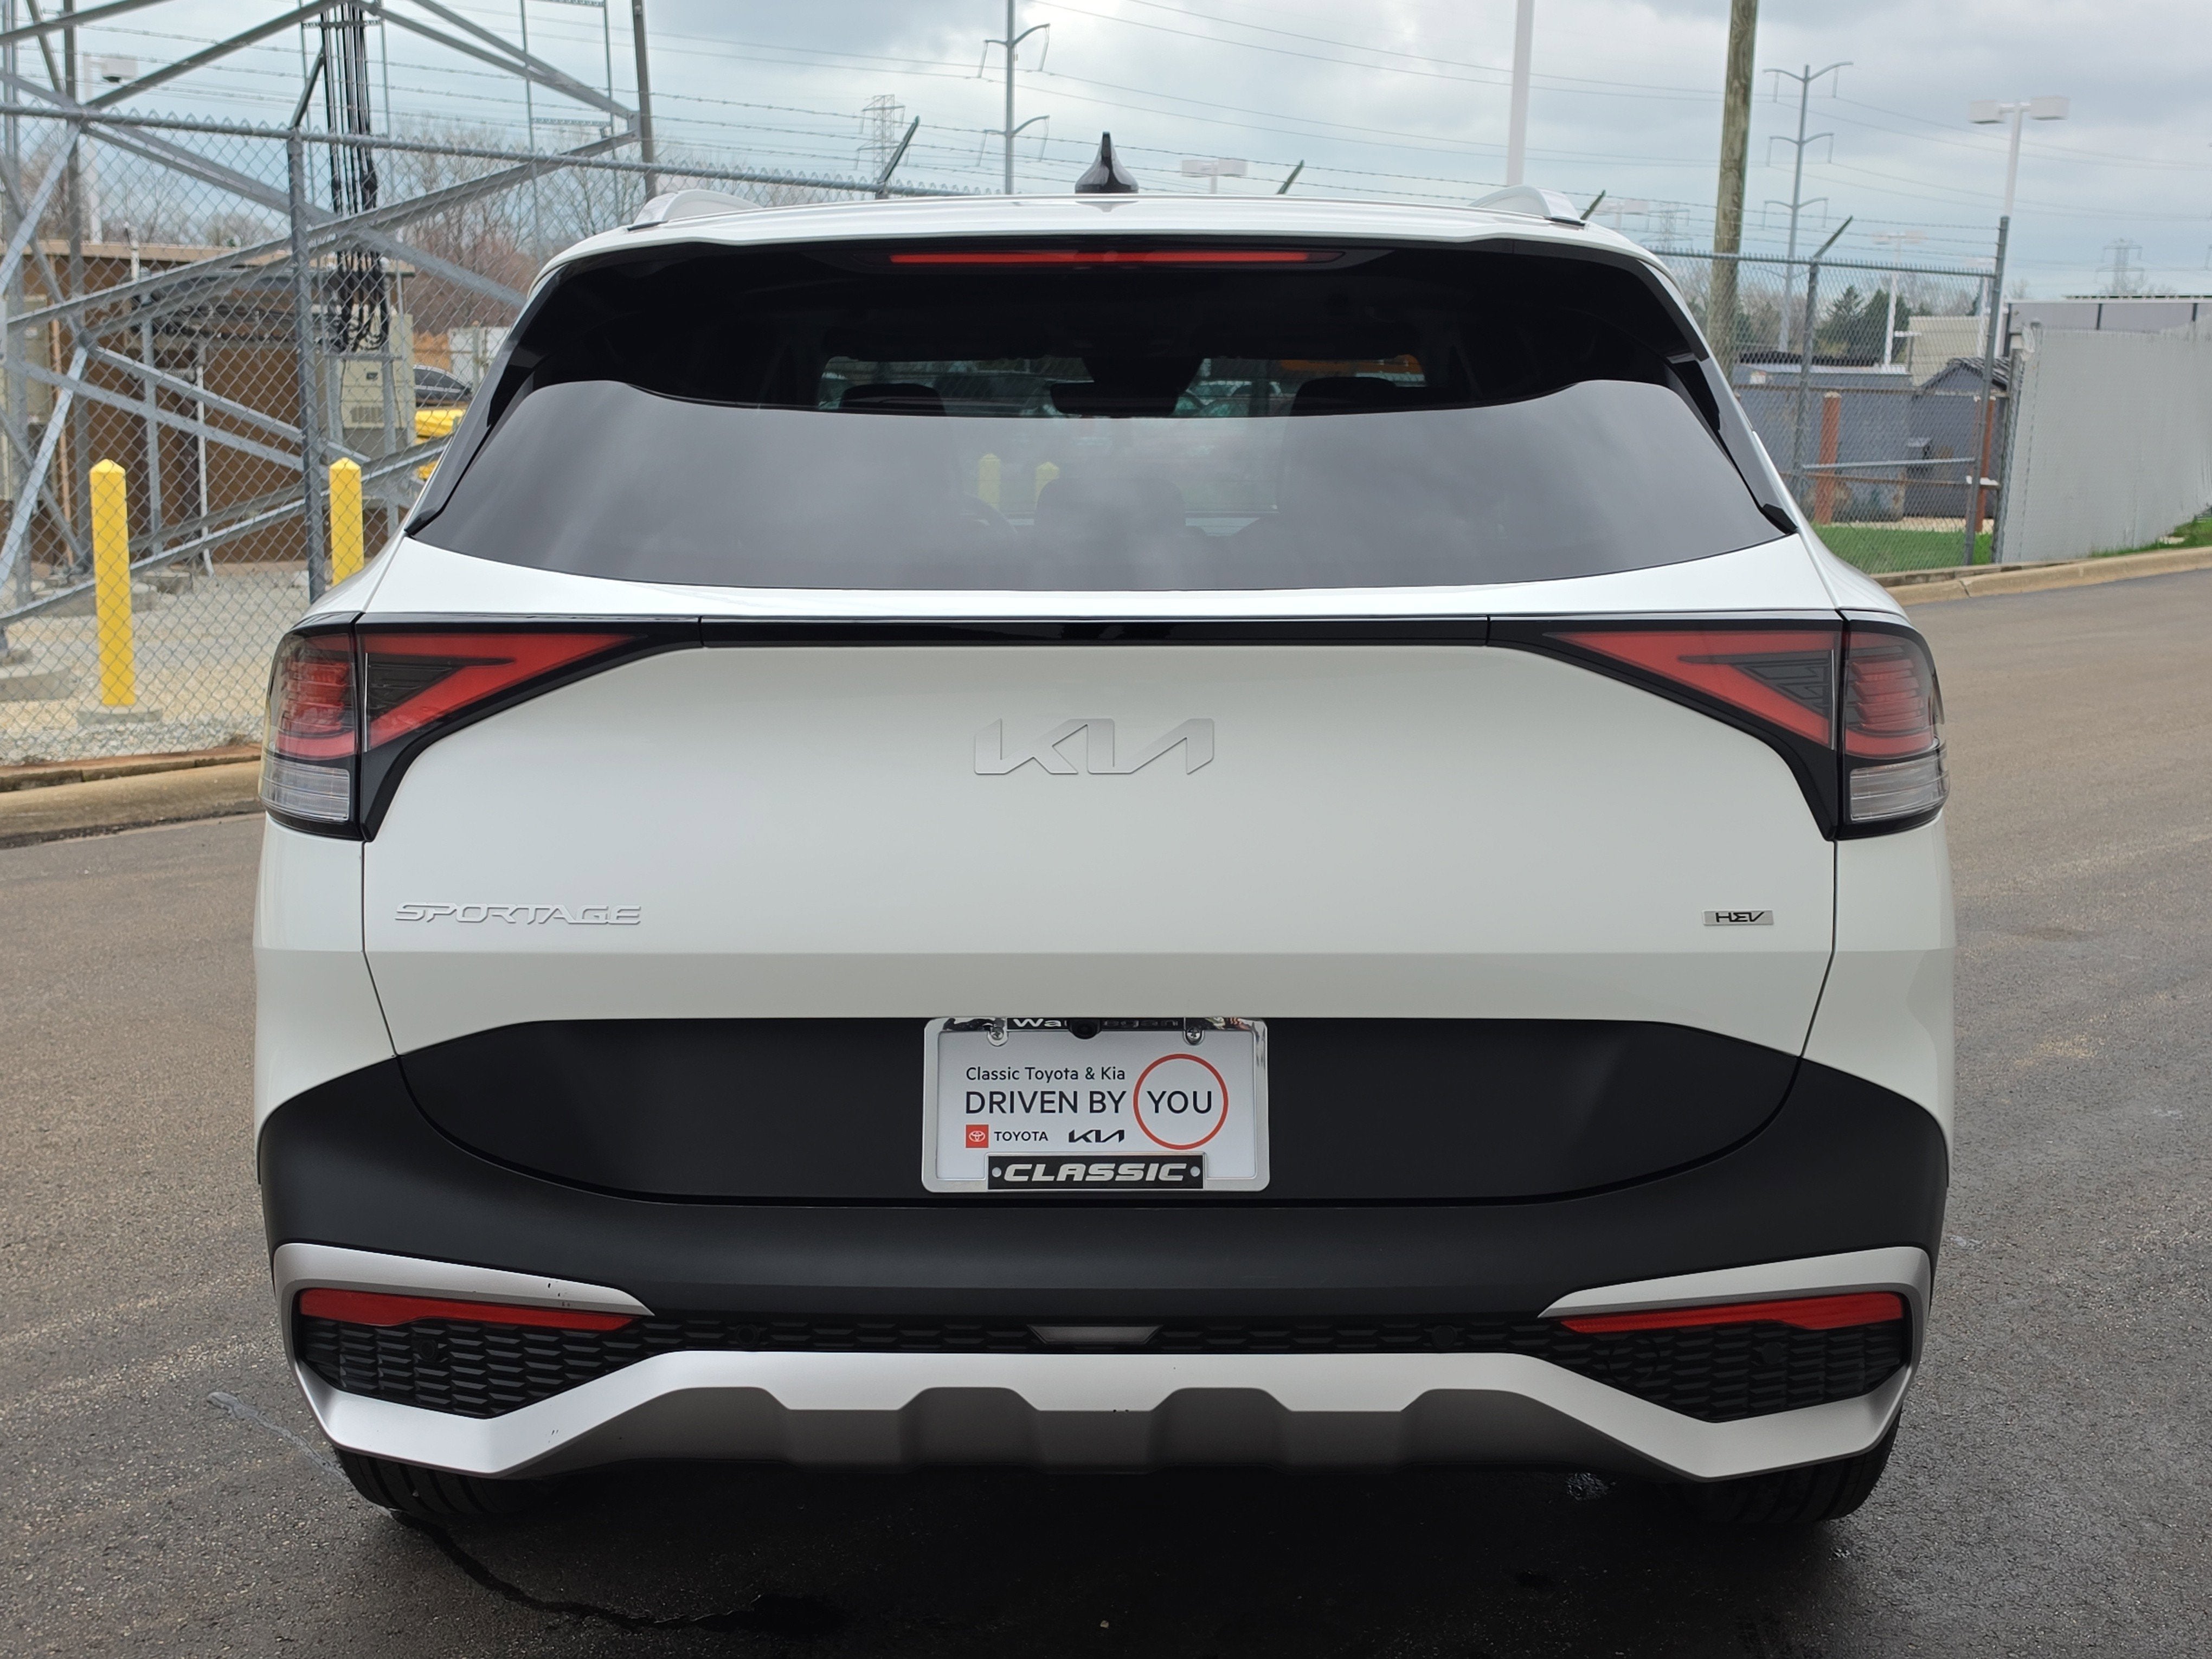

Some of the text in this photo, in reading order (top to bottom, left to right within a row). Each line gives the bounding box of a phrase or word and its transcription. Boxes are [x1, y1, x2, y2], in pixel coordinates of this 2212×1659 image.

[974, 718, 1214, 775] KIA
[394, 902, 641, 925] SPORTAGE
[1715, 911, 1764, 923] HEV
[966, 1066, 1125, 1083] Classic Toyota & Kia
[966, 1090, 1212, 1114] DRIVEN BY YOU
[994, 1131, 1049, 1141] TOYOTA
[1068, 1130, 1125, 1143] KIA
[1004, 1163, 1187, 1182] CLASSIC
